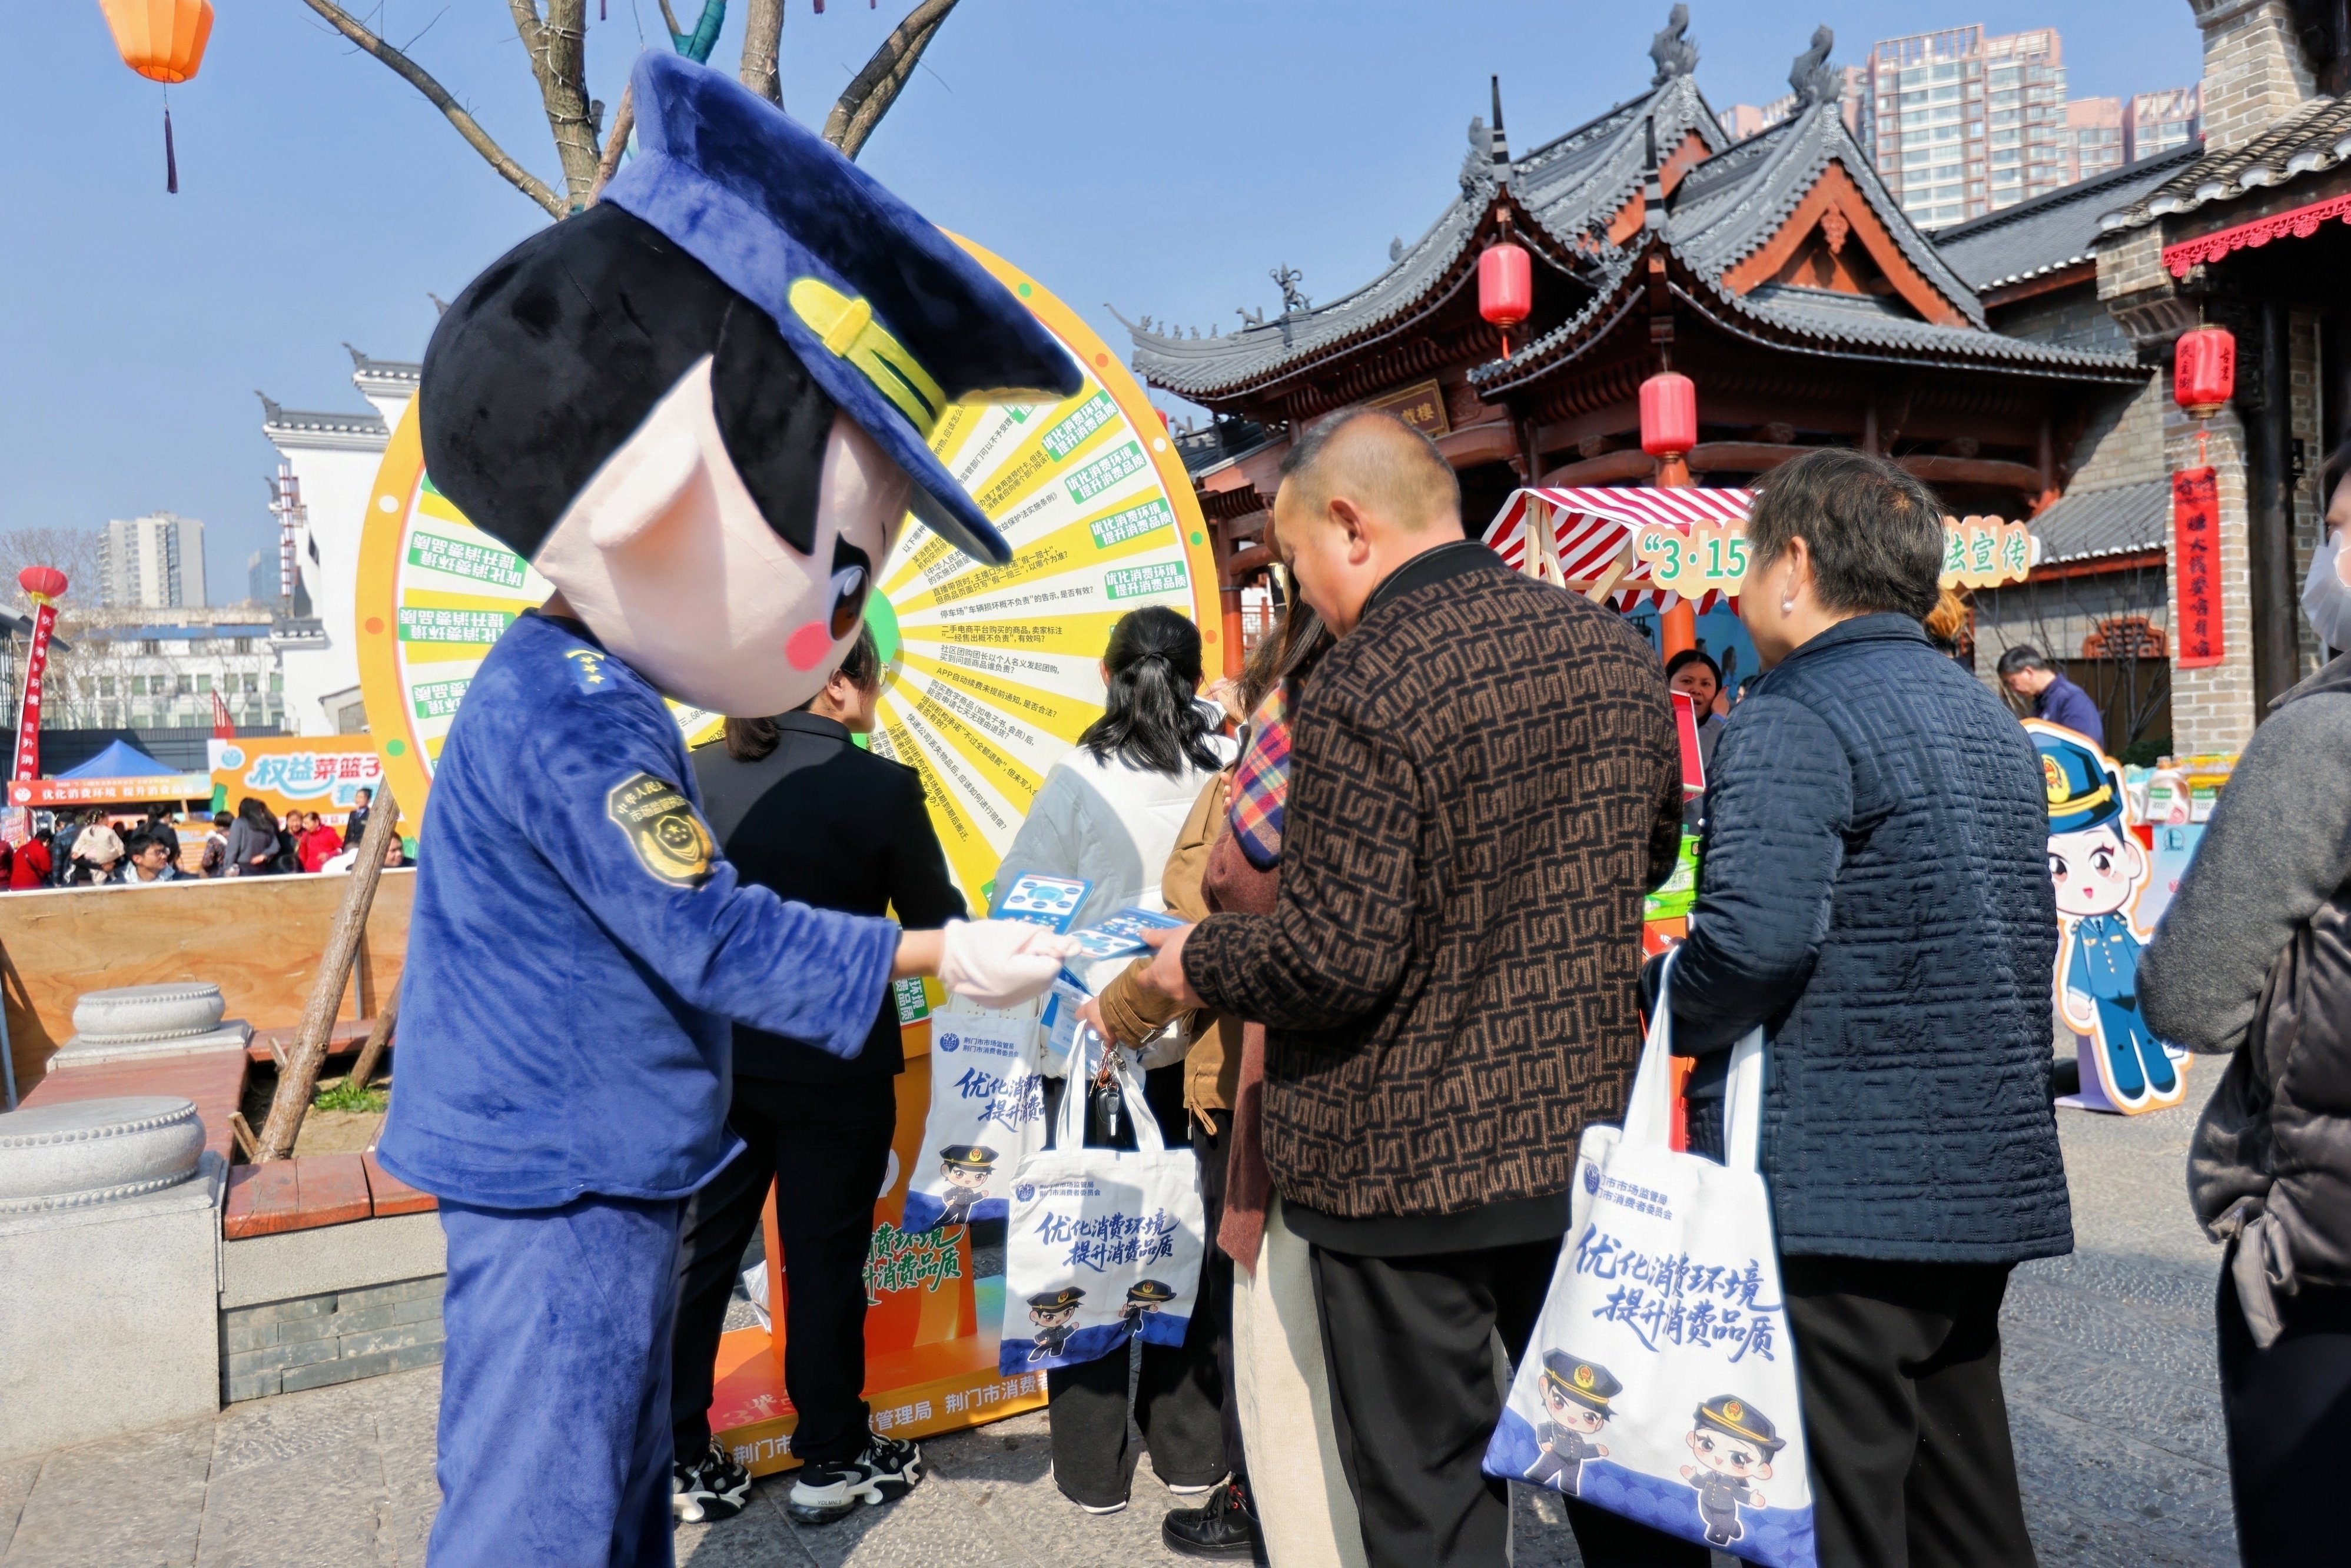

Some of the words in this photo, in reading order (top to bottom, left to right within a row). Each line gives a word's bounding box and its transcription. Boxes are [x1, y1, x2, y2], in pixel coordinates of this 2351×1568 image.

[1042, 396, 1105, 450] 优化消费环境
[1055, 401, 1117, 456] 提升消费品质
[1067, 446, 1133, 491] 优化消费环境
[1079, 453, 1145, 499] 提升消费品质
[1091, 502, 1161, 536] 优化消费环境
[1102, 511, 1172, 545] 提升消费品质
[412, 533, 516, 570] 提升消费品质
[902, 524, 927, 553] 以下哪种
[420, 552, 523, 587] 优化消费环境
[1105, 564, 1177, 586] 优化消费环境
[1115, 575, 1187, 597] 提升消费品质
[400, 609, 504, 627] 提升消费品质
[915, 702, 948, 730] 是否有效？
[250, 756, 381, 792] 权益菜篮子
[911, 976, 925, 1010] 环境
[963, 1045, 1018, 1058] 荆门市消费者委员会
[964, 1037, 1014, 1049] 荆门市市场监管局
[1039, 1181, 1094, 1190] 荆门市市场监管局
[1040, 1189, 1101, 1198] 荆门市消费者委员会
[1034, 1208, 1180, 1245] 优化消费环境
[1062, 1234, 1173, 1273] 提升消费品质
[1576, 1223, 1781, 1313] 优化消费环境
[862, 1247, 962, 1305] 升消费品质
[1593, 1284, 1775, 1363] 提升消费品质
